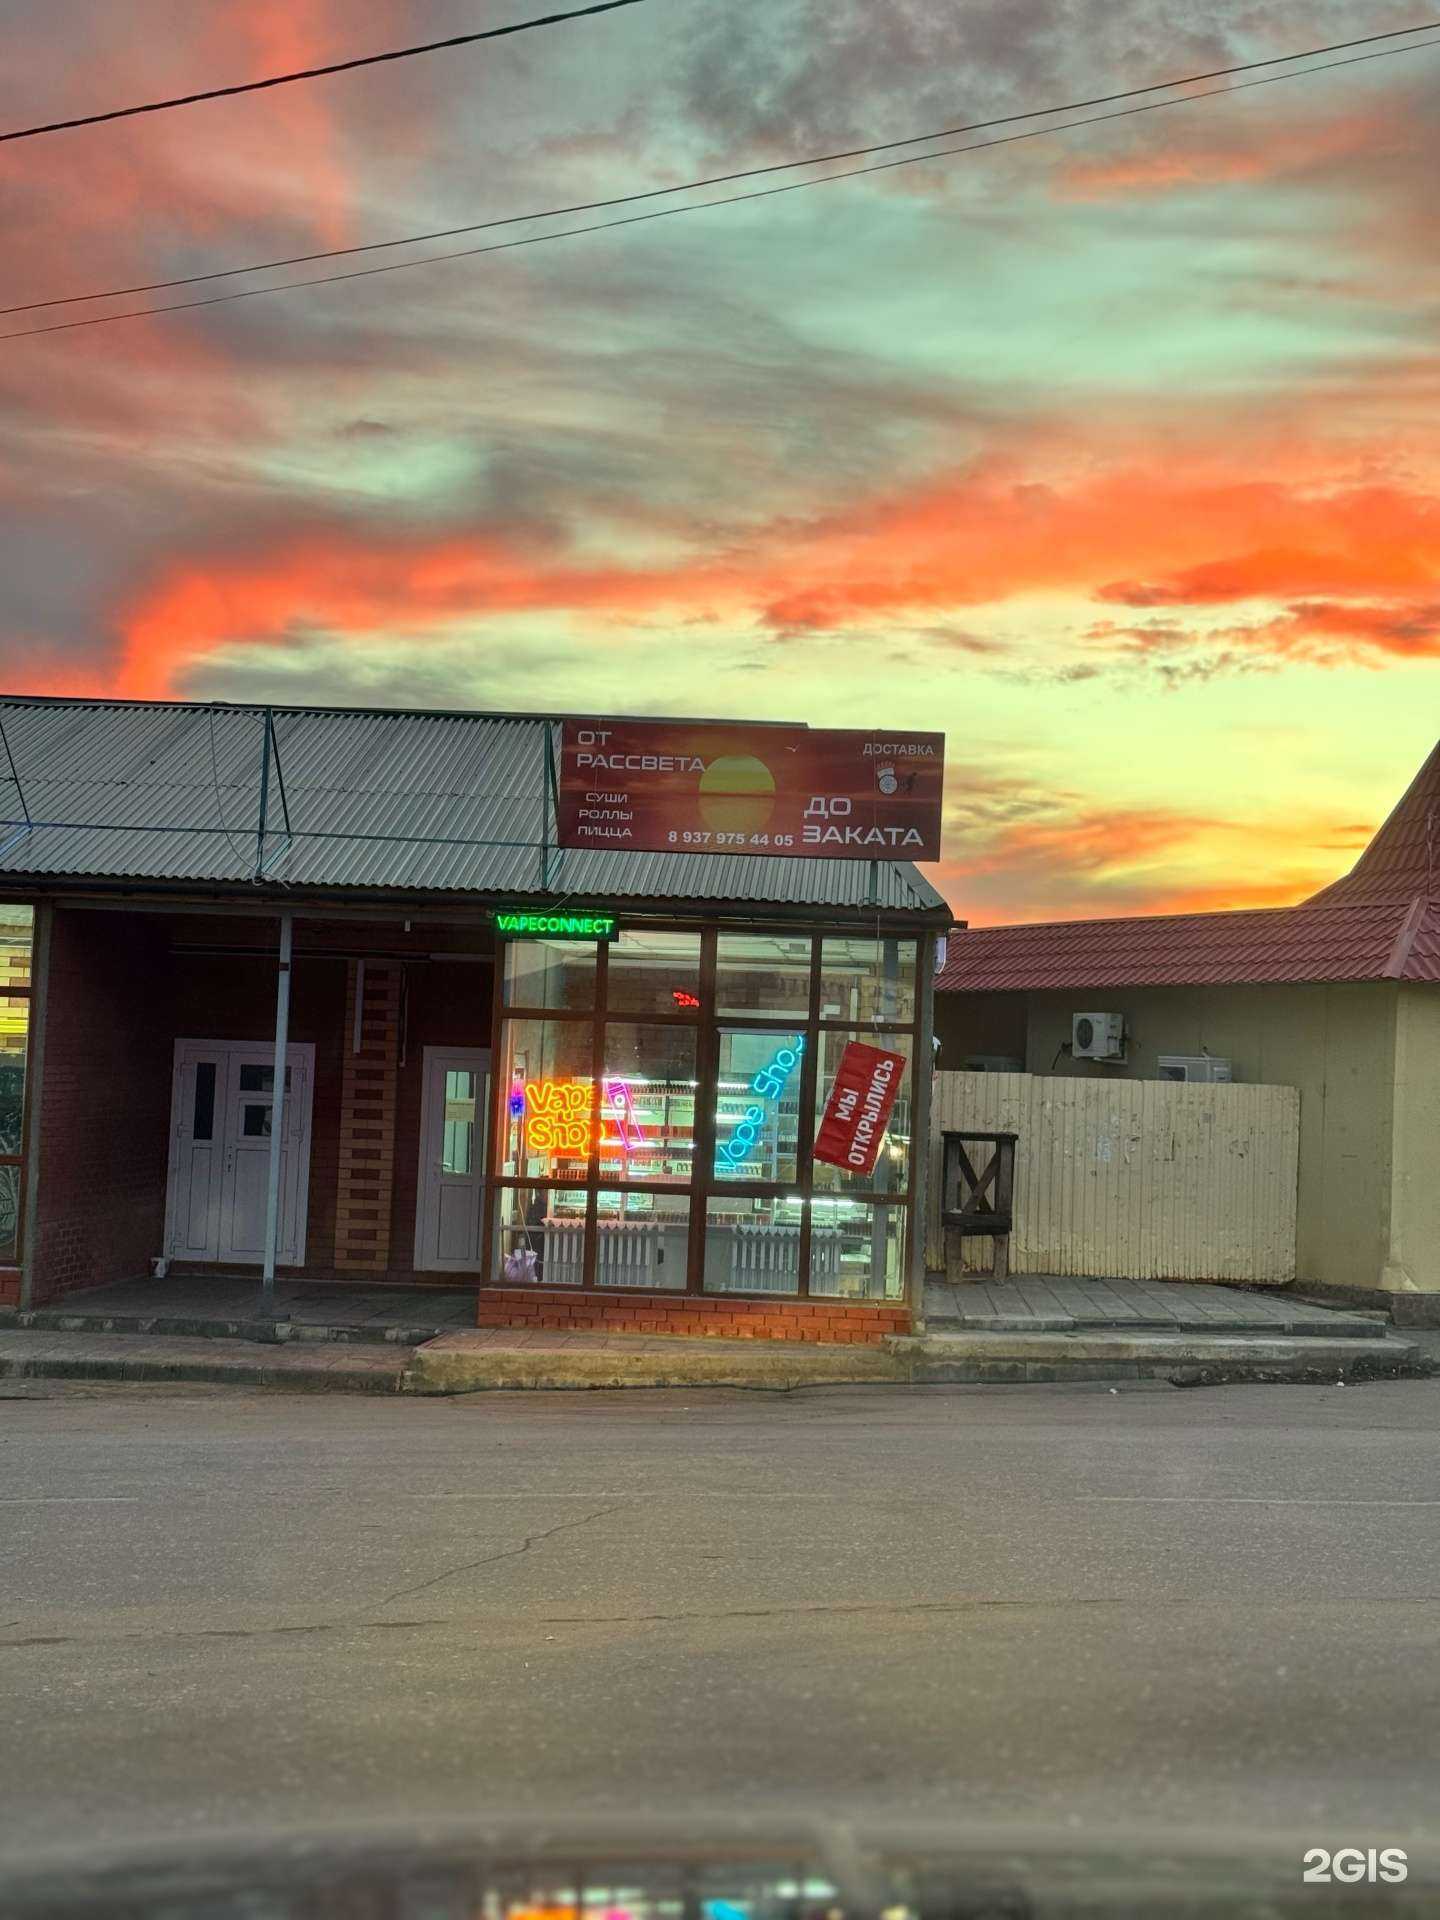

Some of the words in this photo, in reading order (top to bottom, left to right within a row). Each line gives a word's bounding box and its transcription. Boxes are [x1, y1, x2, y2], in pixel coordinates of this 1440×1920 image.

[577, 731, 612, 746] ОТ
[863, 743, 934, 755] ДОСТАВКА
[577, 754, 706, 772] РАССВЕТА
[585, 792, 628, 803] СУШИ
[578, 809, 633, 820] РОЛЛЫ
[803, 797, 851, 819] ДО
[578, 826, 632, 838] ПИЦЦА
[668, 831, 677, 842] 8
[682, 832, 711, 844] 937
[717, 833, 744, 845] 975
[749, 834, 769, 846] 44
[774, 835, 793, 846] 05
[803, 825, 924, 846] ЗАКАТА
[497, 916, 614, 933] VAPECONNECT
[835, 1088, 859, 1121] МЫ
[847, 1059, 894, 1166] ОТКРЫЛИСЬ
[714, 1106, 764, 1171] Vape
